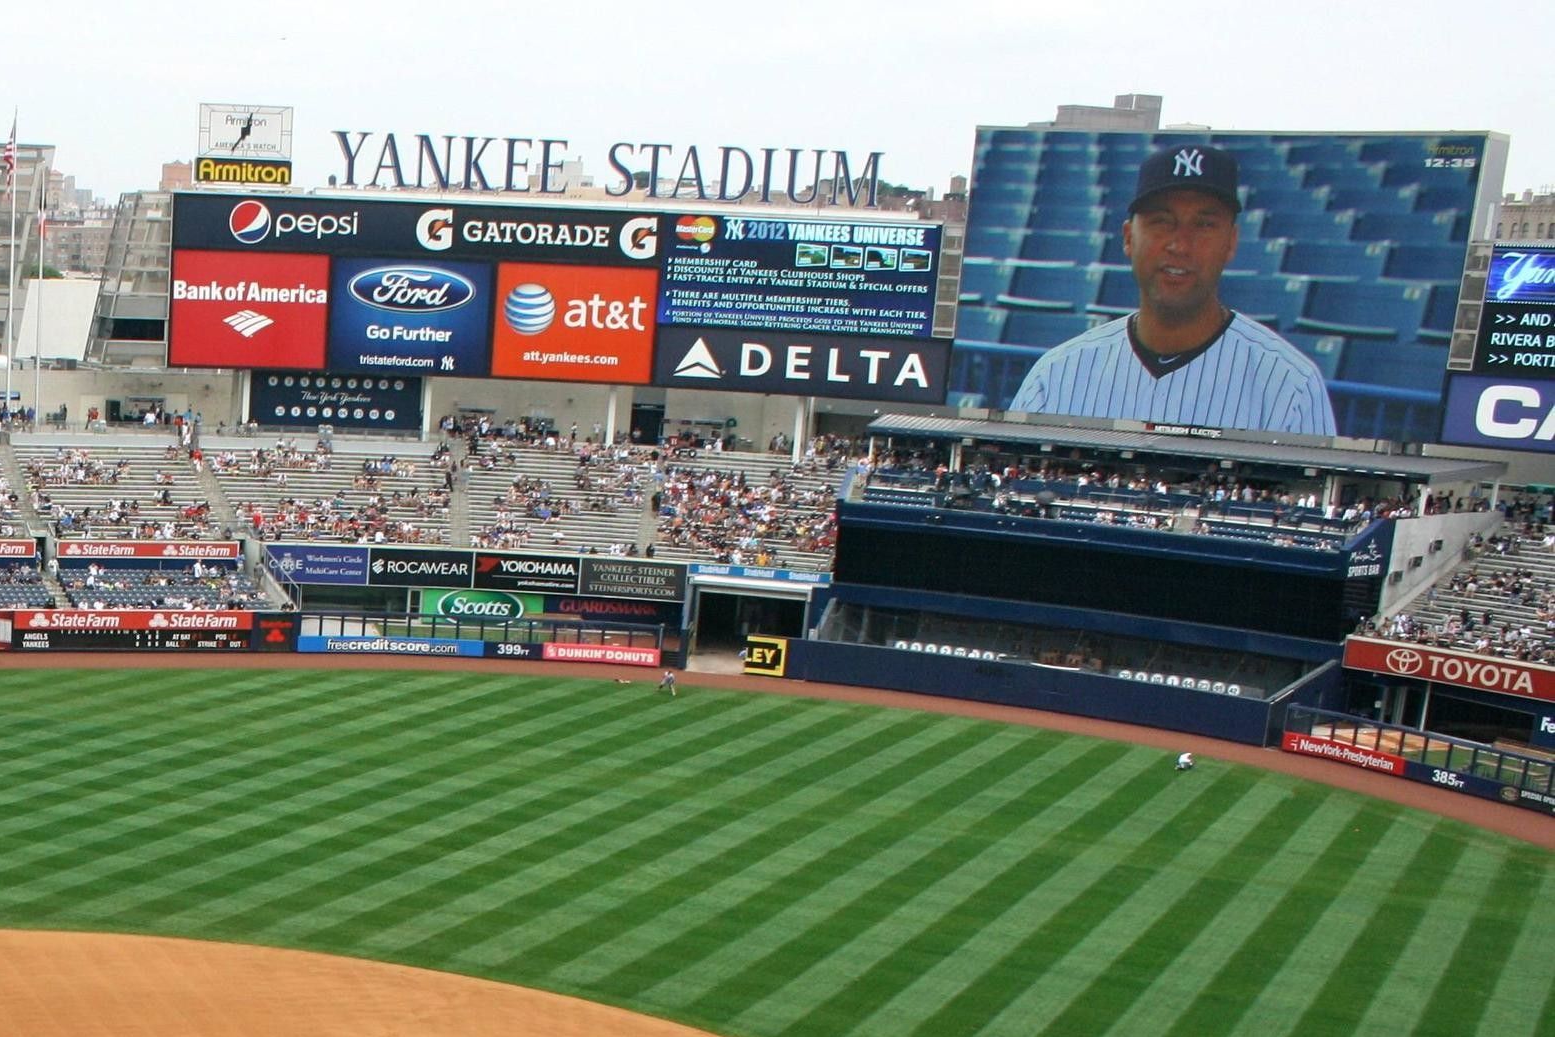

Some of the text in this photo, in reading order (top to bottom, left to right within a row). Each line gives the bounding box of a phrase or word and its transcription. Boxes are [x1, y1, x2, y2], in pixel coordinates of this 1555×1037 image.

[198, 159, 290, 183] Armitron
[331, 130, 886, 208] YANKEE STADIUM
[1425, 158, 1476, 168] 12:35
[276, 211, 359, 240] pepsi
[416, 209, 658, 260] G GATORADE G
[675, 225, 715, 234] MasterCard
[747, 222, 785, 240] 2012
[788, 224, 851, 243] YANKEES
[853, 226, 925, 246] UNIVERSE
[673, 258, 758, 268] MEMBERSHIP CARD
[673, 266, 724, 275] DISCOUNTS
[740, 268, 778, 277] YANKEES
[781, 270, 833, 280] CLUBHOUSE
[837, 272, 865, 282] SHOPS
[173, 280, 327, 305] Bank of America
[371, 271, 448, 306] Ford
[673, 274, 928, 293] FAST-TRACK ENTRY AT YANKEE STADIUM & SPECIAL OFFERS
[672, 290, 700, 298] THERE
[703, 292, 719, 300] ARE
[721, 293, 763, 302] MULTIPLE
[765, 296, 823, 306] MEMBERSHIP
[563, 294, 647, 331] at&t
[672, 299, 711, 308] BENEFITS
[713, 300, 733, 308] AND
[735, 302, 805, 312] OPPORTUNITIES
[807, 306, 849, 314] INCREASE
[852, 308, 876, 316] WITH
[879, 308, 903, 318] EACH
[1520, 313, 1551, 326] AND
[366, 325, 453, 343] Go Further
[1491, 333, 1541, 347] RIVERA
[359, 354, 435, 369] tristateford.com
[523, 350, 619, 368] att.yankees.com
[739, 343, 929, 388] DELTA
[387, 562, 469, 576] ROCAWEAR
[501, 560, 575, 575] YOKOHAMA
[637, 566, 676, 576] STEINER
[600, 574, 666, 586] COLLECTIBLES
[450, 597, 511, 616] Scotts
[327, 638, 457, 654] freecreditscore.com
[558, 648, 655, 663] DUNKIN' DONUTS
[1428, 655, 1534, 694] TOYOTA
